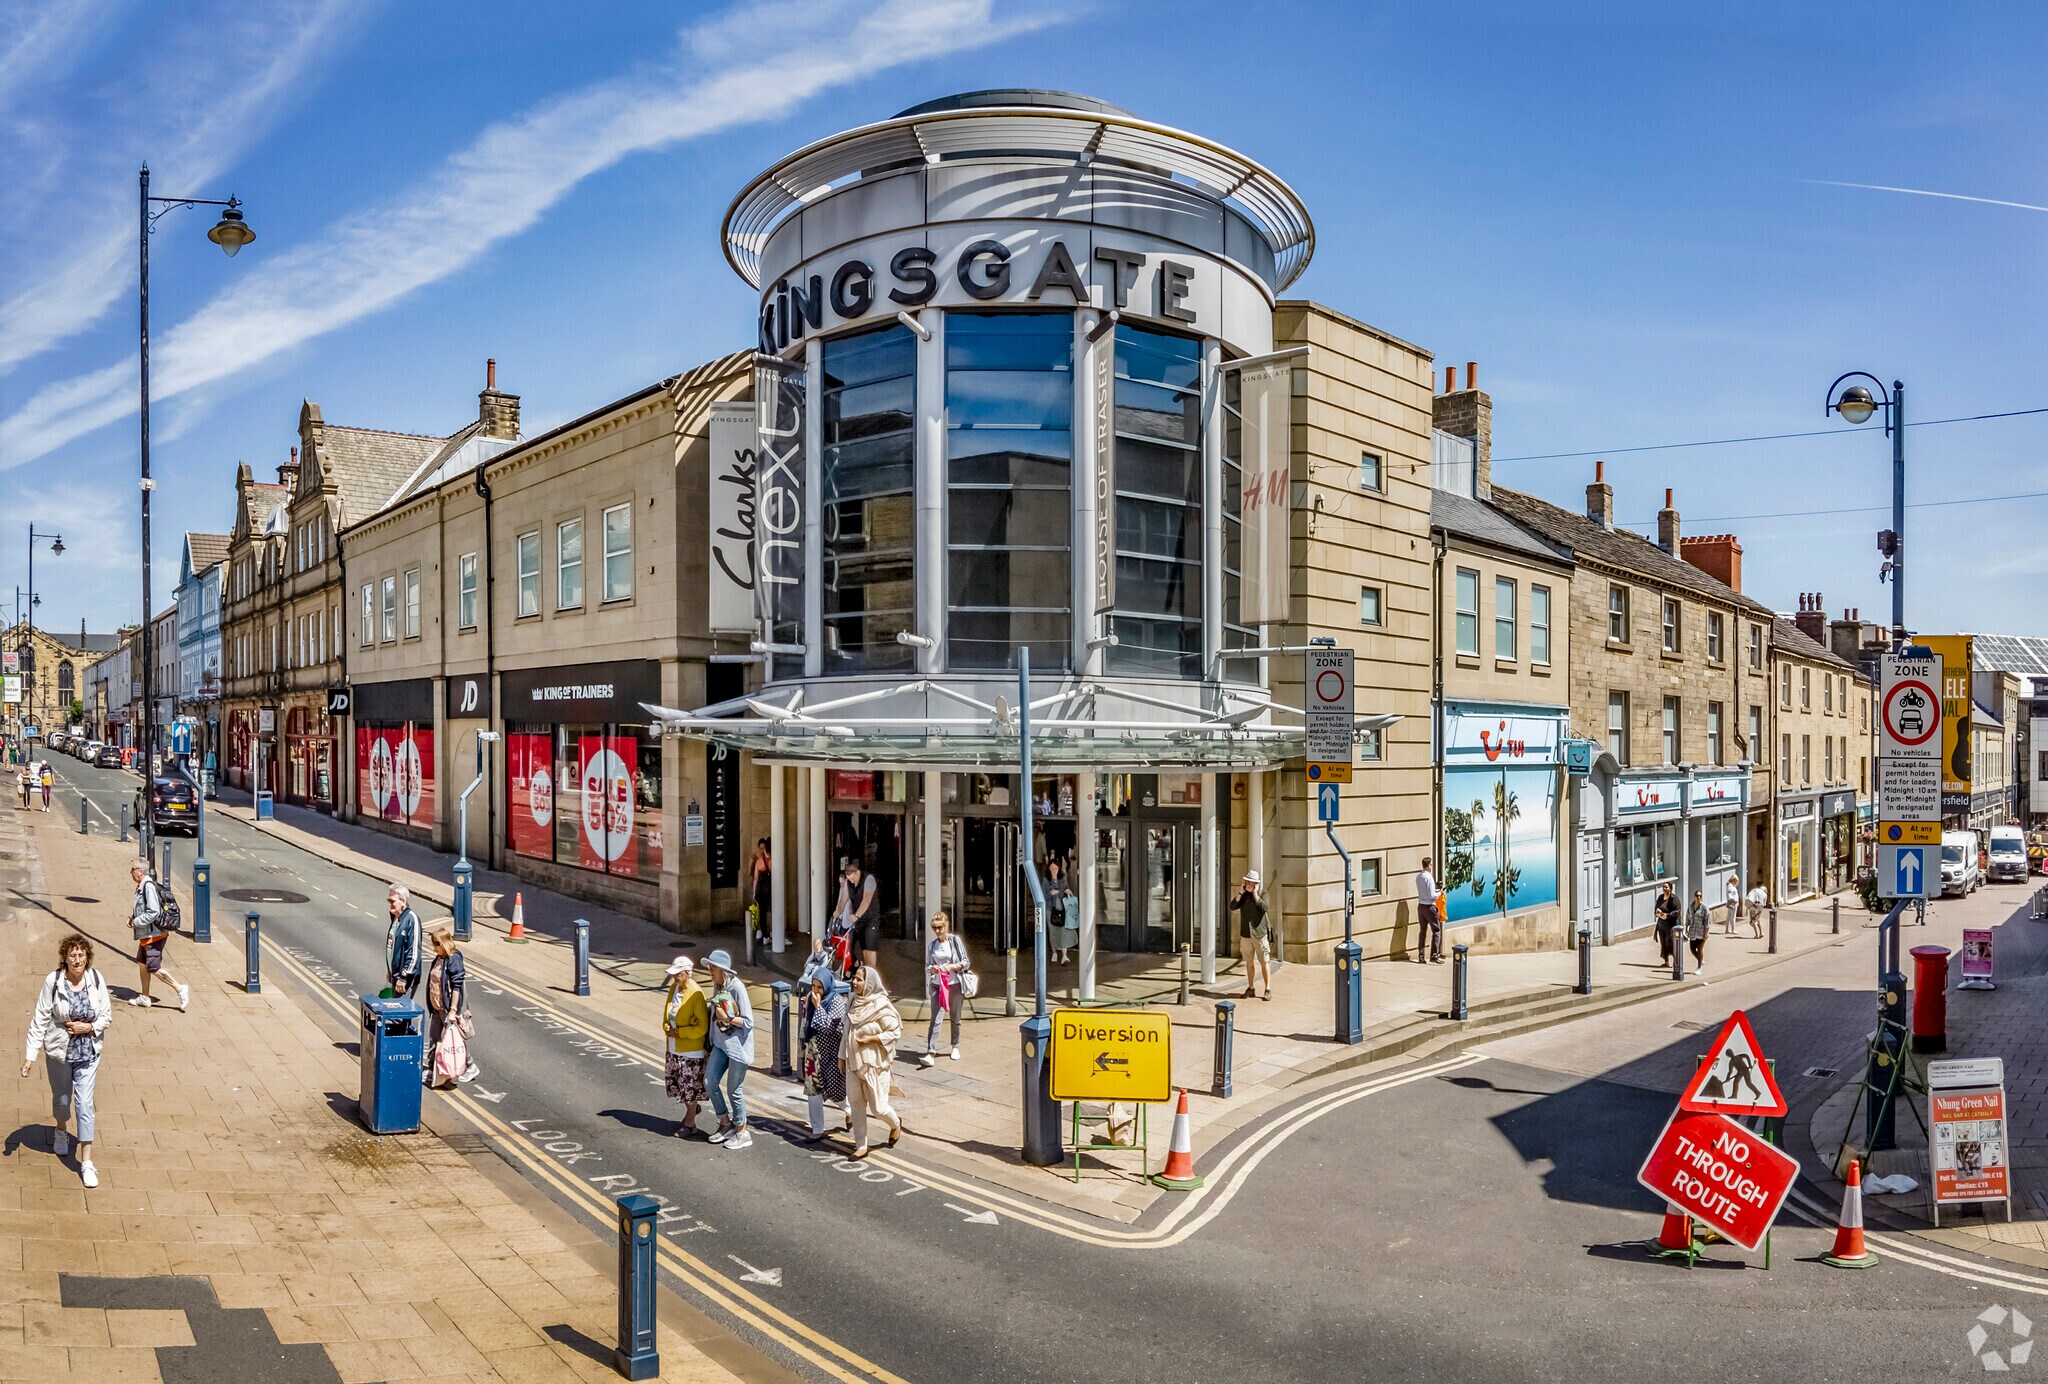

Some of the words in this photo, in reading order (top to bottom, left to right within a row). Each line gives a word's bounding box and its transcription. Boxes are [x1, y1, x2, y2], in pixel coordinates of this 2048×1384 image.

[759, 239, 1197, 355] KINGSGATE
[1098, 358, 1108, 454] FRASER
[758, 401, 800, 585] next
[1098, 465, 1108, 500] OF
[1243, 468, 1288, 511] H&M
[712, 448, 756, 591] Clarks
[1098, 508, 1108, 600] HOUSE
[1315, 658, 1344, 667] ZONE
[1894, 665, 1929, 676] ZONE
[460, 680, 478, 712] JD
[544, 686, 563, 700] KING
[563, 685, 571, 699] OF
[571, 684, 614, 699] TRAINERS
[1943, 678, 1966, 699] ELE
[329, 694, 348, 710] JD
[711, 742, 728, 761] JD
[1891, 749, 1901, 757] No
[1903, 749, 1931, 757] vehicles
[1892, 761, 1917, 769] Except
[1911, 779, 1937, 787] loading
[1896, 804, 1934, 812] designated
[1913, 833, 1929, 841] time
[1064, 1023, 1159, 1043] Diversion
[568, 1039, 642, 1067] LOOK
[1937, 1097, 1960, 1112] Nhung
[1961, 1096, 1983, 1109] Green
[1984, 1095, 1999, 1107] Nail
[511, 1118, 603, 1165] LOOK
[1716, 1131, 1750, 1163] NO
[1674, 1135, 1769, 1209] THROUGH
[1671, 1169, 1742, 1225] ROUTE
